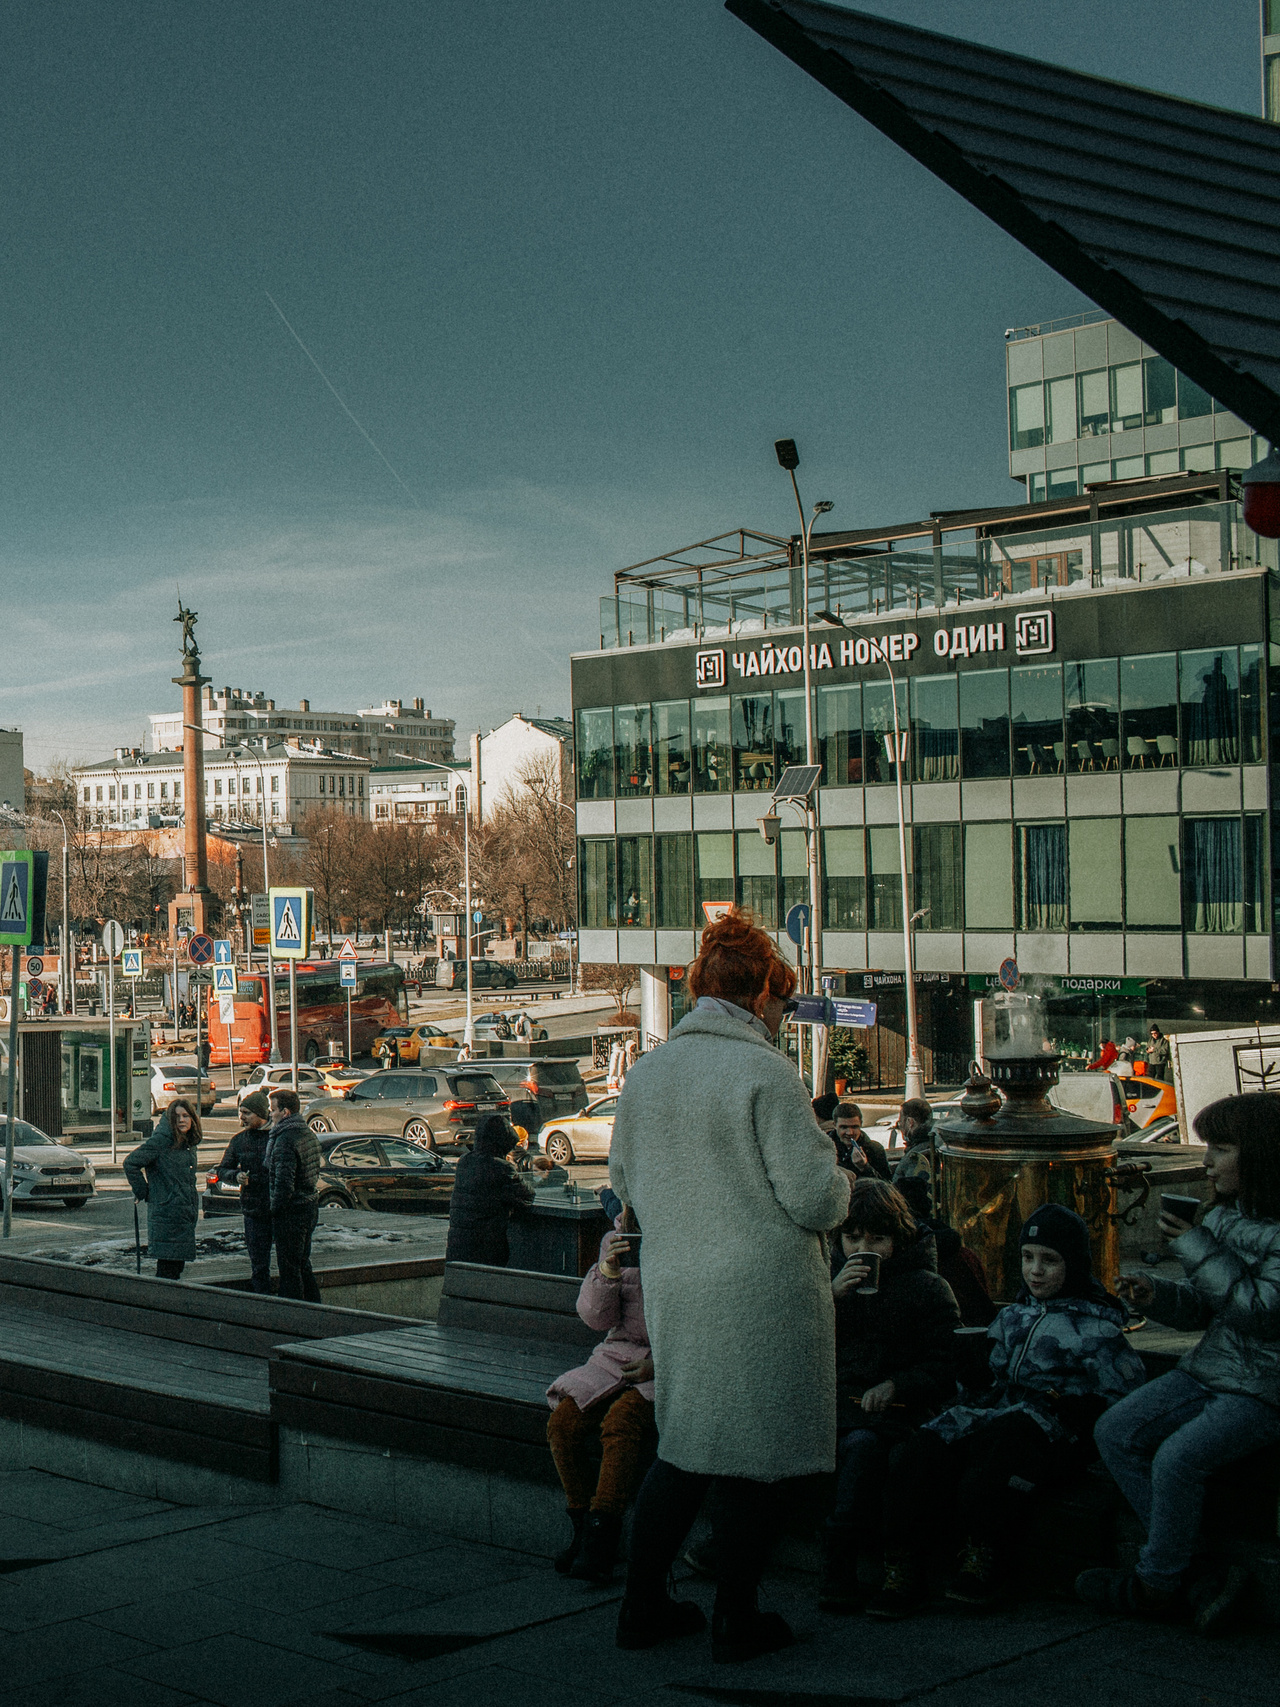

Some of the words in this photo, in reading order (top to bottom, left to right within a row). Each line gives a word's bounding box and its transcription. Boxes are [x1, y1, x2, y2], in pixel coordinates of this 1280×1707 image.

[732, 643, 834, 678] ЧАЙХОНА
[840, 633, 919, 667] НОМЕР
[933, 622, 1005, 658] ОДИН
[30, 962, 41, 971] 50
[902, 974, 923, 983] НЕР
[1061, 978, 1121, 992] подарки
